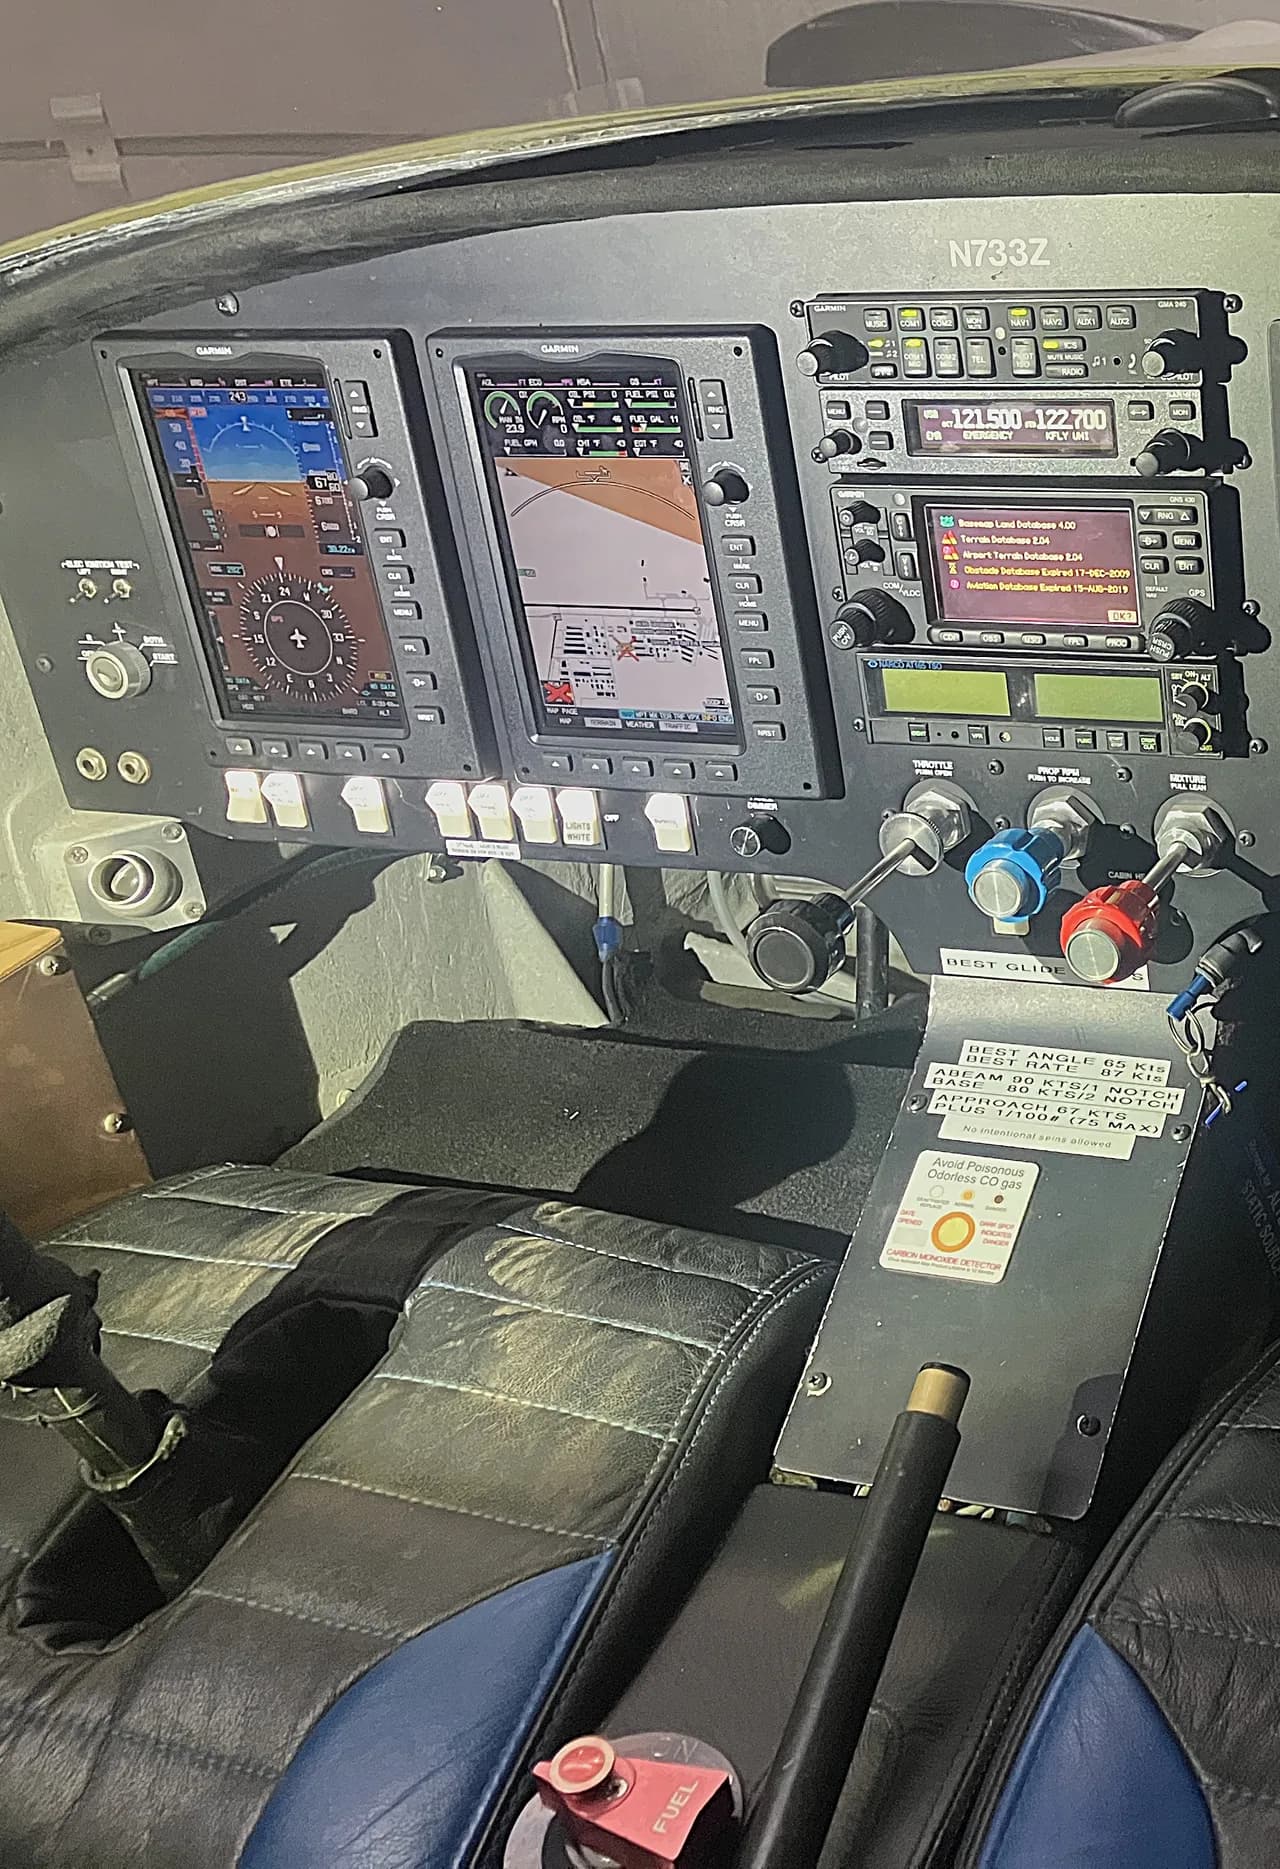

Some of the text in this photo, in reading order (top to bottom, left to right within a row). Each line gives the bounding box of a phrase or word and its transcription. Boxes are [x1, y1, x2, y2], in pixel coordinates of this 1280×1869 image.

[950, 238, 1050, 267] N733Z
[865, 320, 887, 328] MUSIC
[900, 320, 921, 328] COM1
[1010, 319, 1030, 327] NAV1
[1076, 318, 1096, 326] AUX1
[541, 345, 579, 353] GARMIN
[904, 353, 925, 361] COM1
[935, 353, 957, 361] COM2
[1062, 368, 1084, 376] RADIO
[229, 391, 247, 401] 243
[707, 406, 724, 414] RNG
[951, 409, 1022, 429] 121.500
[505, 424, 525, 434] 23.9
[560, 424, 568, 433] 0
[963, 431, 1068, 440] EMERGENCY KFLY
[314, 477, 327, 489] 67
[1157, 512, 1174, 520] RNG
[724, 519, 746, 527] CRSR
[995, 519, 1016, 529] Land
[1017, 521, 1057, 530] Database
[1058, 521, 1076, 530] 4.00
[960, 535, 1050, 545] Terrain Database 2.04
[1175, 535, 1195, 545] MENU
[963, 552, 1083, 562] Airport Terrain Database 2.04
[1144, 562, 1160, 570] CLR
[1000, 567, 1040, 576] Database
[1041, 568, 1073, 578] Expired
[1075, 569, 1130, 579] 17-DEC-2009
[735, 582, 750, 590] CLR
[966, 581, 1129, 593] Aviation Database Expired 15-AUG-2019
[279, 587, 291, 596] 24
[1188, 589, 1206, 597] GPS
[260, 593, 272, 603] 21
[320, 610, 333, 619] 30
[1112, 611, 1132, 621] OK?
[738, 619, 759, 627] MENU
[253, 634, 265, 644] 15
[332, 633, 345, 642] 33
[266, 657, 277, 667] 12
[748, 657, 762, 665] FPL
[286, 673, 294, 683] E
[625, 720, 655, 729] WEATHER
[664, 722, 692, 730] TRAFFIC
[757, 729, 776, 738] NRST
[913, 760, 953, 770] THROTTLE
[1061, 768, 1080, 777] RPM
[1169, 774, 1206, 784] MIXTURE
[1170, 783, 1188, 791] PULL
[565, 822, 591, 831] LIGHTS
[567, 833, 591, 841] WHITE
[1108, 871, 1133, 879] CABIN
[946, 958, 1066, 975] BEST GLIDE
[969, 1045, 1021, 1057] BEST
[1028, 1051, 1097, 1066] ANGLE
[1104, 1059, 1126, 1069] 65
[966, 1054, 1018, 1066] BEST
[1025, 1061, 1079, 1073] RATE
[1100, 1068, 1123, 1078] 87
[934, 1068, 1181, 1101] ABEAM 90 KTS/1 NOTCH
[932, 1077, 1176, 1110] BASE 80 KTS/2 NOTCH
[936, 1093, 1127, 1121] APPROACH 67 KTS
[933, 1102, 1159, 1134] PLUS 1/100# (75 MAX)
[963, 1124, 977, 1133] No
[980, 1126, 1036, 1141] intentional
[1071, 1136, 1112, 1148] allowed
[932, 1157, 1025, 1177] Avoid Poisonous
[927, 1168, 1023, 1190] Odorless CO gas
[1242, 1180, 1267, 1227] STATIC
[886, 1248, 919, 1259] CARBON
[919, 1252, 960, 1265] MONOXIDE
[960, 1259, 1002, 1270] DETECTOR
[652, 1779, 700, 1834] FUEL
